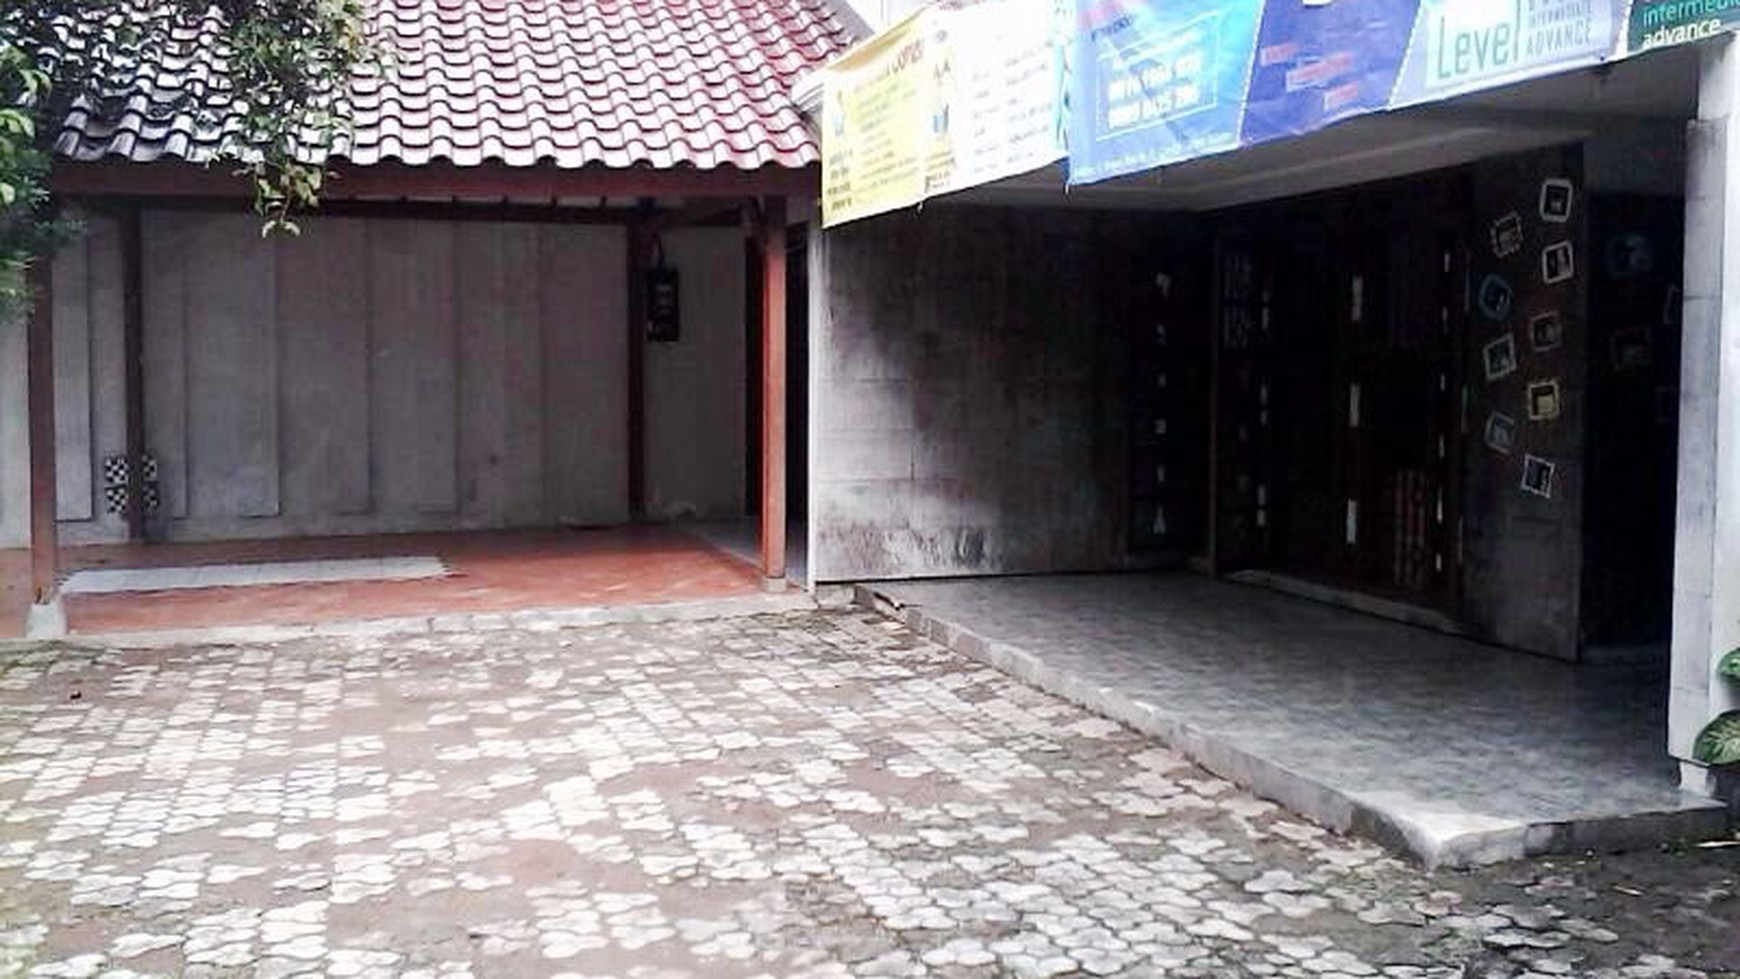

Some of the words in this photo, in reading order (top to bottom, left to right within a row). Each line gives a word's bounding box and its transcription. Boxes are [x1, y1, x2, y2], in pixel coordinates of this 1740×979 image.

[1437, 0, 1521, 79] Level
[1527, 17, 1592, 56] ADVANCE
[1642, 18, 1721, 50] advance
